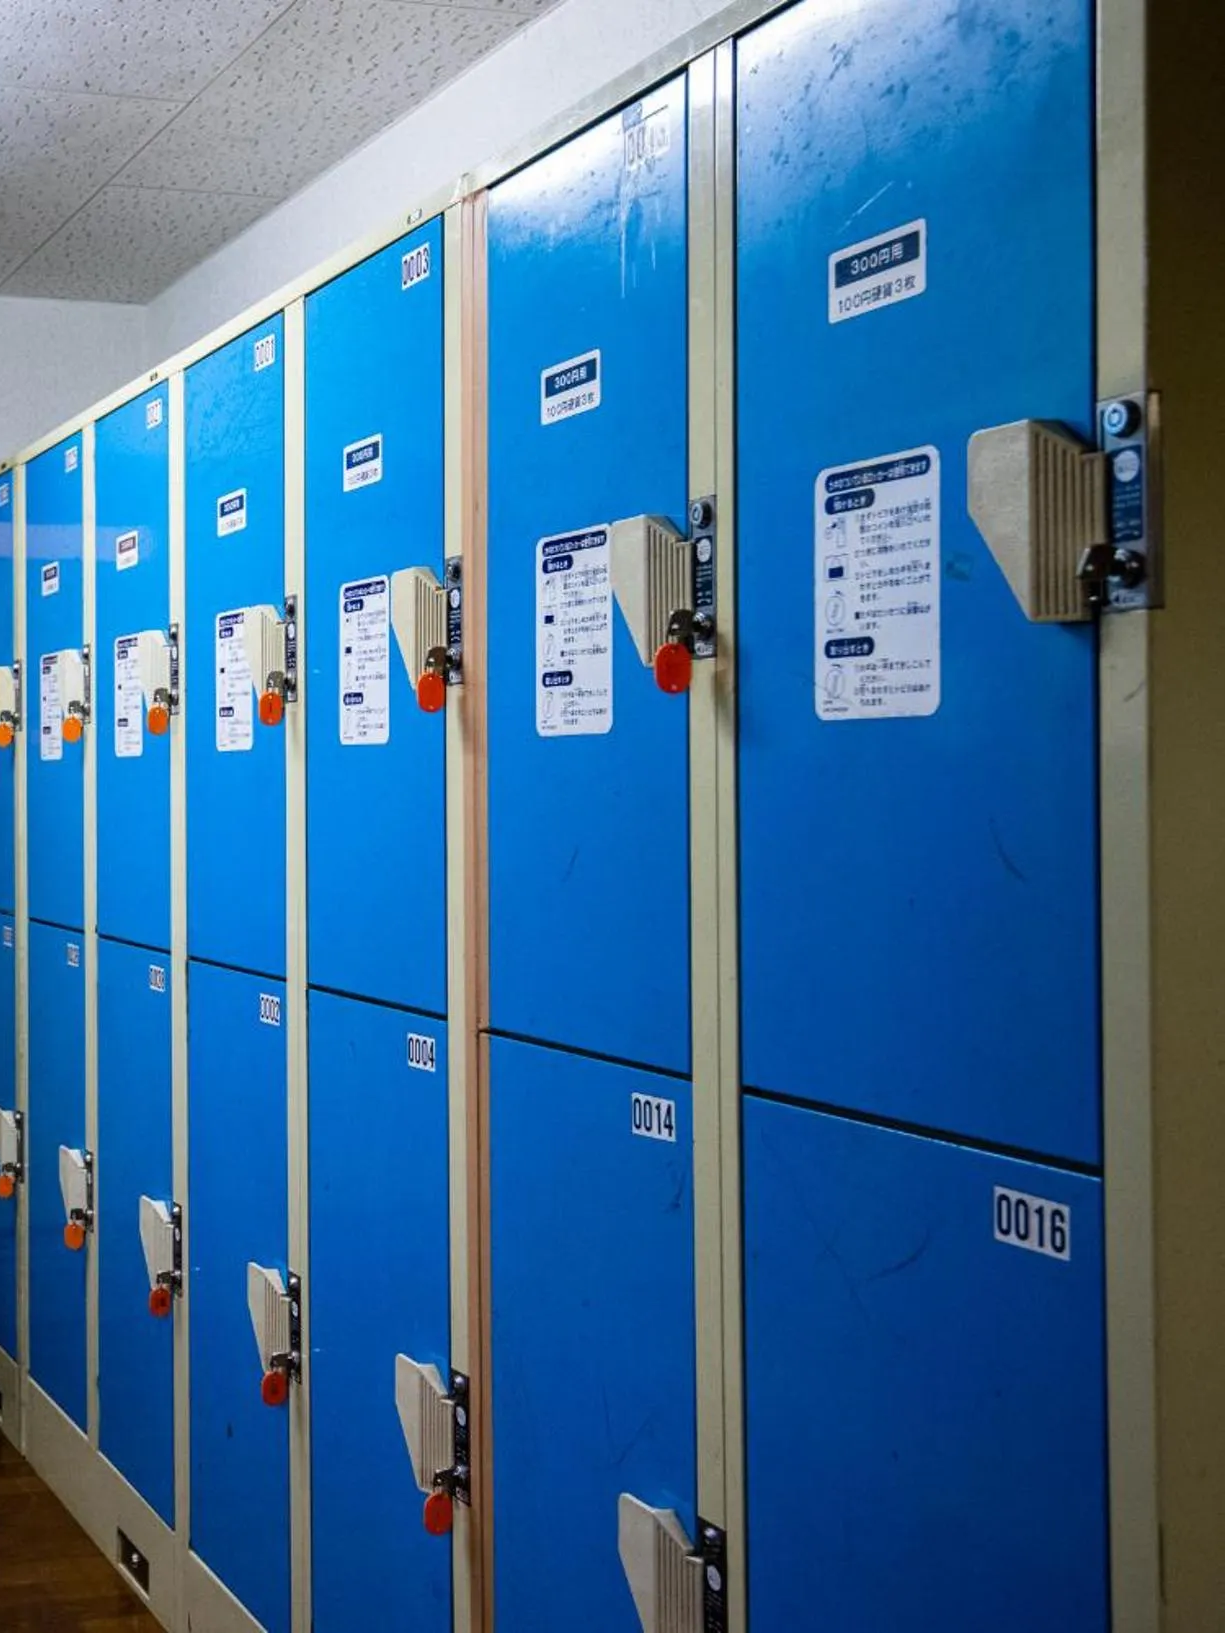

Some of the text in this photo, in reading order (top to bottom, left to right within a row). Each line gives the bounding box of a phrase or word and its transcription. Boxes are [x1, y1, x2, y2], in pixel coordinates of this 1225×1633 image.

[850, 242, 904, 275] 300円用
[408, 1037, 434, 1068] 0004
[633, 1097, 673, 1137] 0014
[997, 1194, 1065, 1253] 0016
